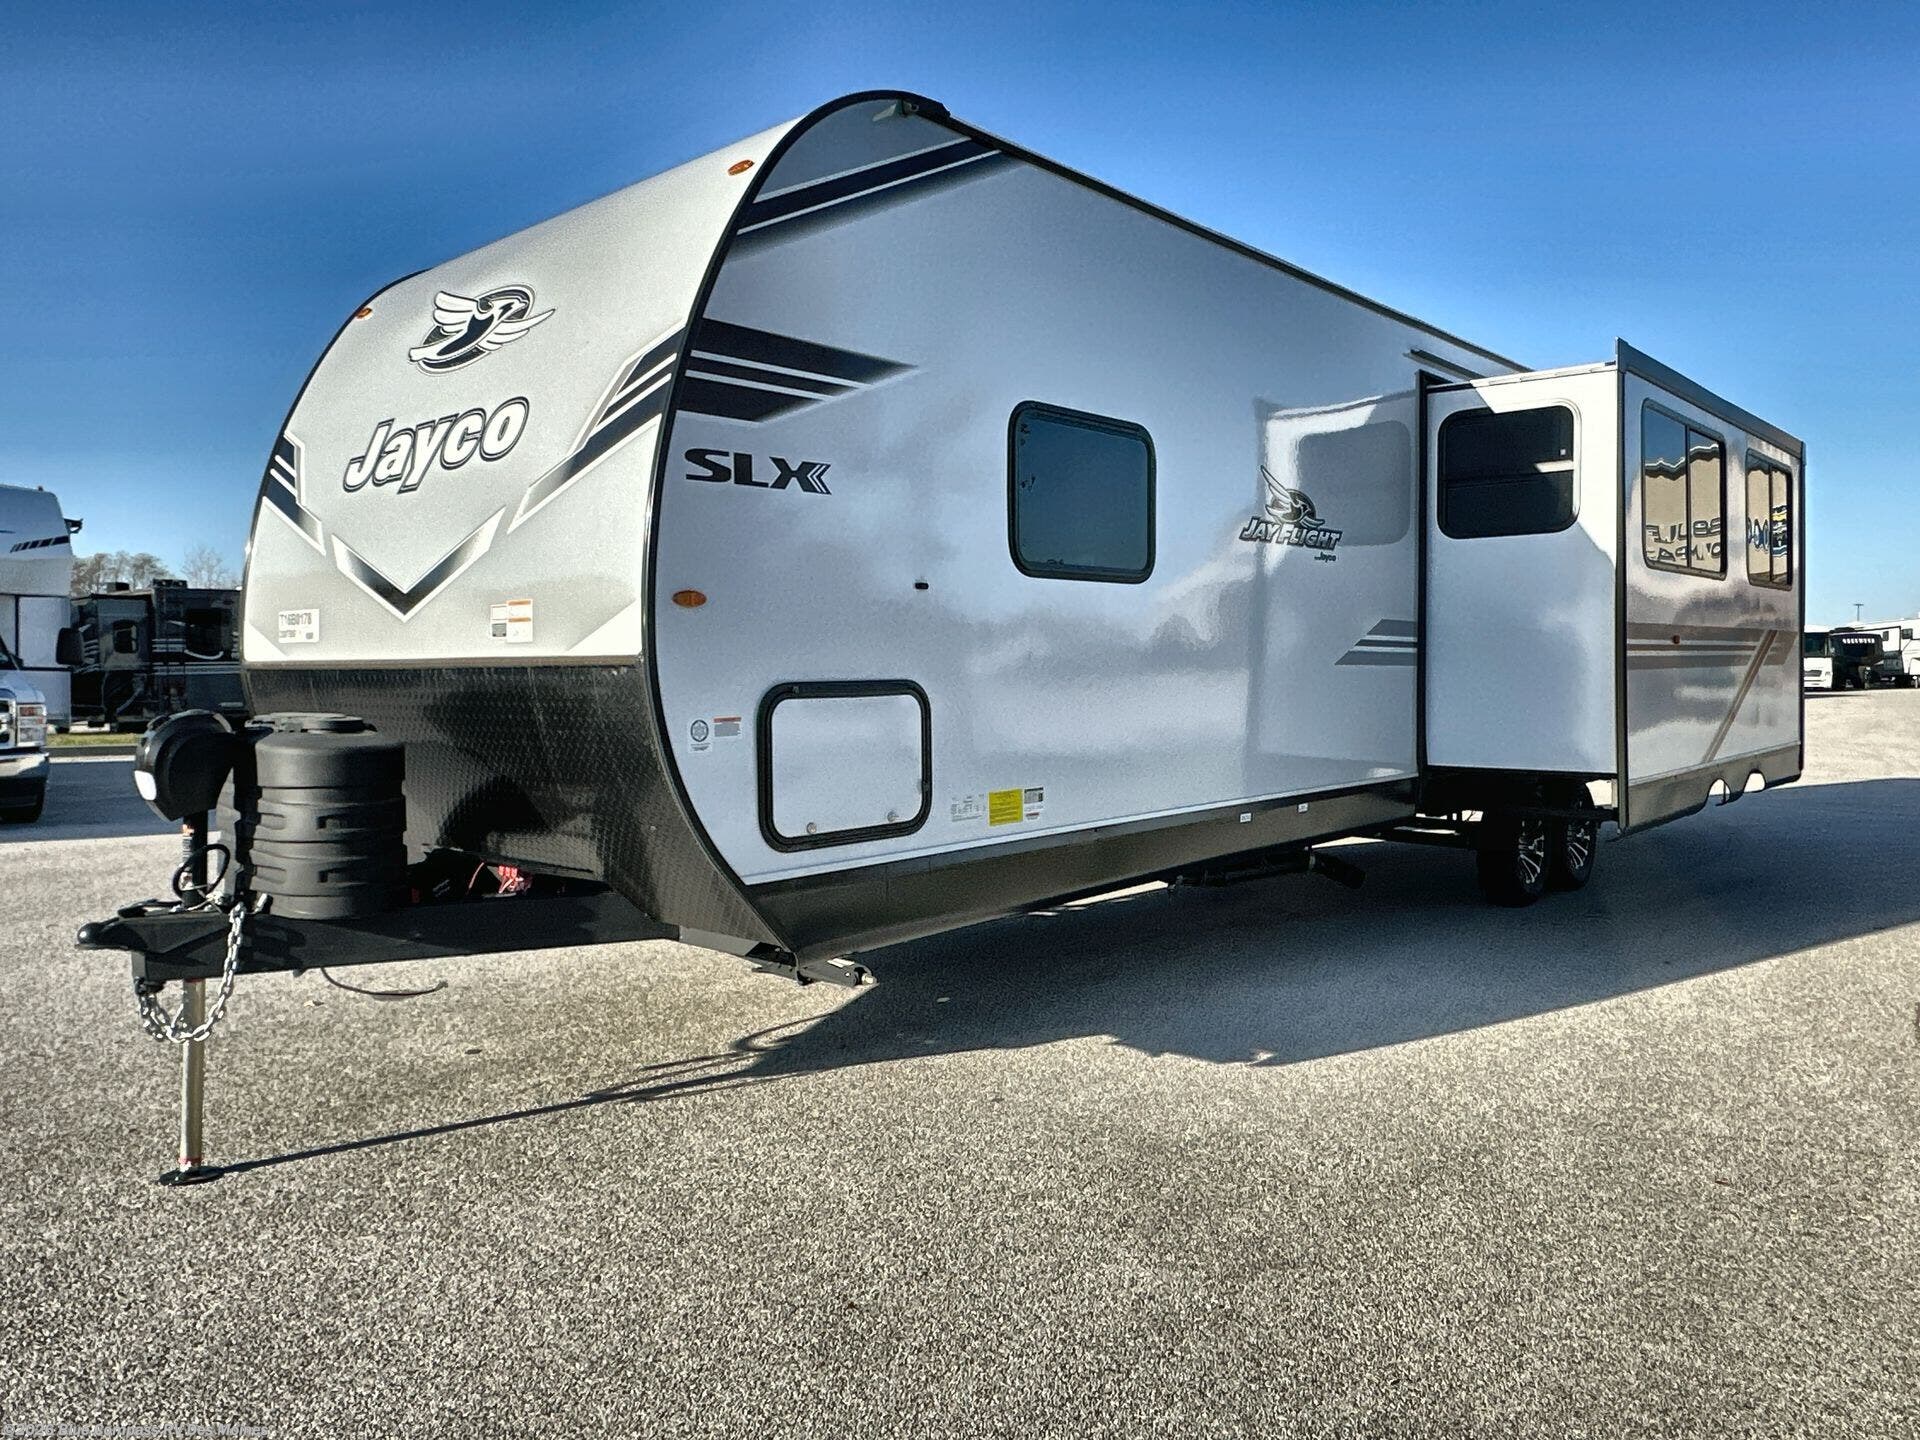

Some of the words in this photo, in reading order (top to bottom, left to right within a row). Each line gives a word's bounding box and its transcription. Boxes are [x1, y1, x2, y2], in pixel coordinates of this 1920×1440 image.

[343, 396, 529, 494] Jayco
[684, 448, 832, 495] SLX
[1239, 516, 1281, 543] JAY
[1276, 521, 1342, 551] FLIGHT
